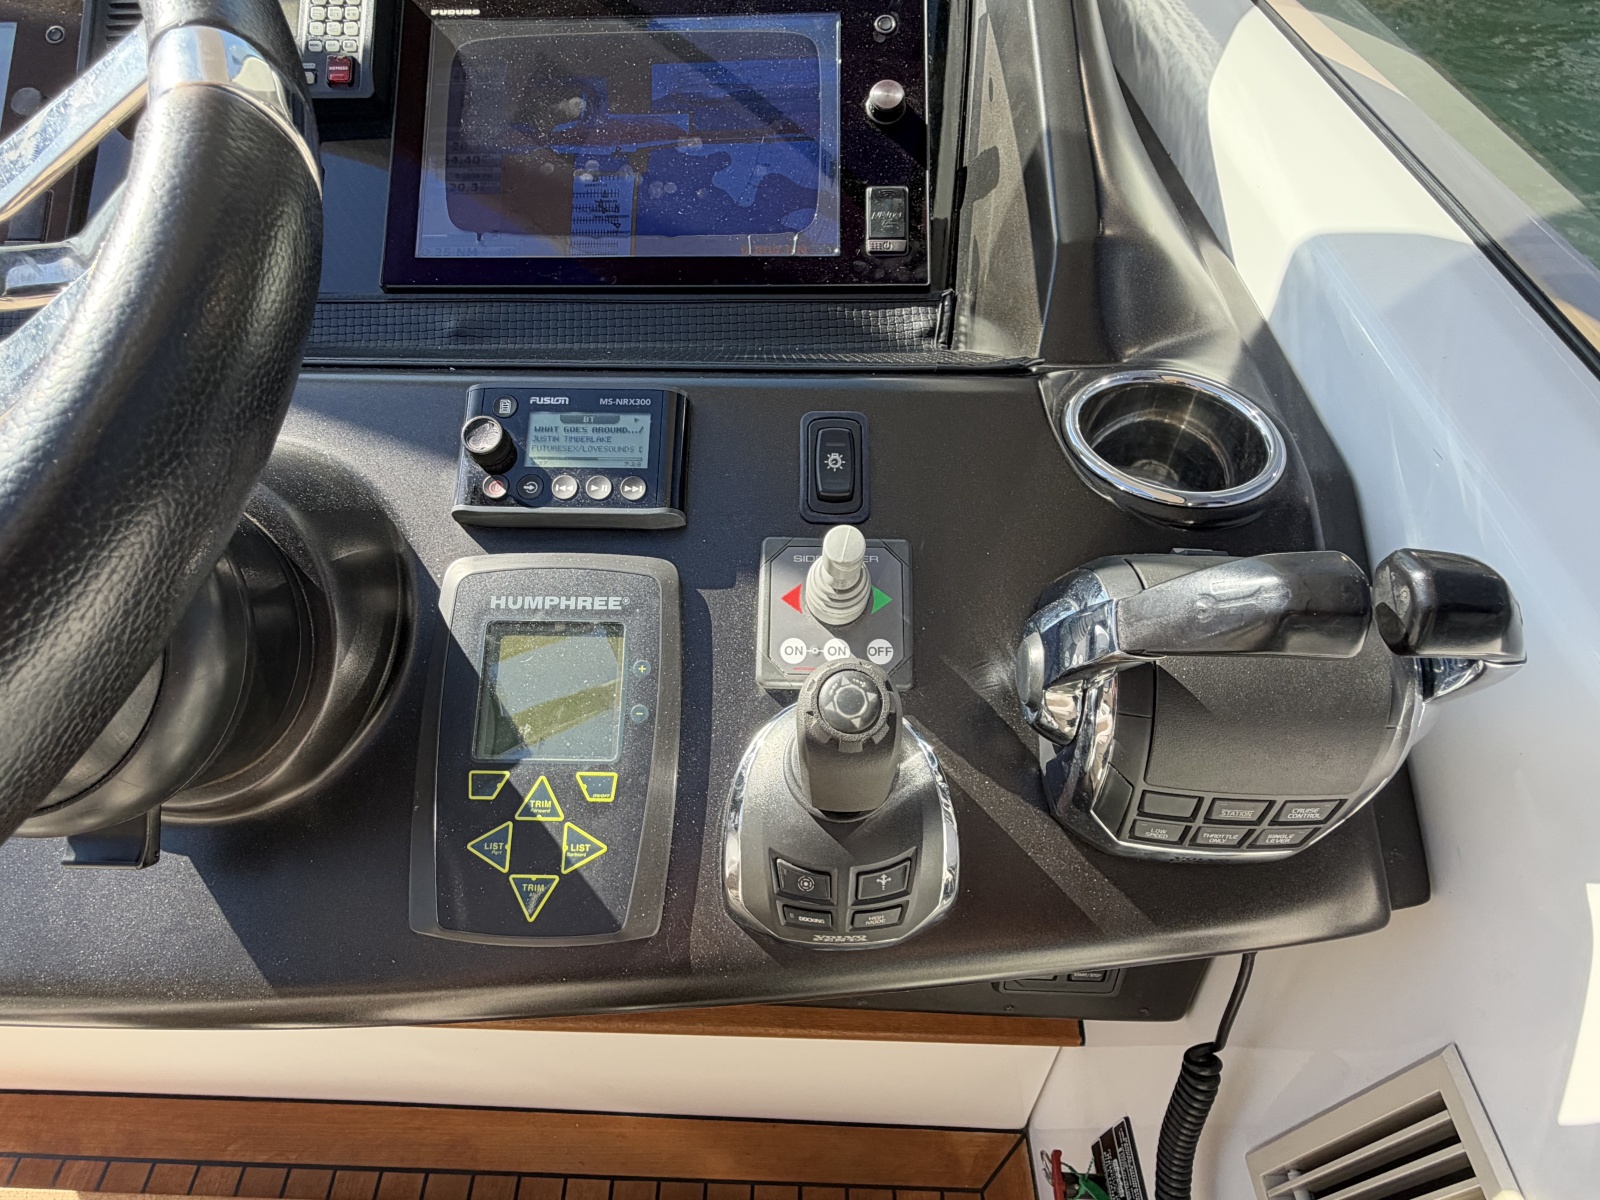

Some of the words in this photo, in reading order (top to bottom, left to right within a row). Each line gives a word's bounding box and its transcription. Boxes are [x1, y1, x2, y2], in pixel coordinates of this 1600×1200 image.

[599, 397, 652, 406] MS-NRX300
[582, 415, 596, 424] BT
[533, 425, 559, 434] WHAT
[563, 426, 588, 434] GOES
[531, 435, 560, 443] JUSTIN
[563, 435, 612, 443] TIMBERLAKE
[490, 595, 623, 610] HUMPHREE
[784, 646, 804, 656] ON
[827, 646, 847, 656] ON
[867, 647, 893, 657] OFF
[530, 800, 552, 808] TRIM
[484, 842, 504, 850] LIST
[570, 844, 591, 852] LIST
[522, 883, 545, 892] TRIM
